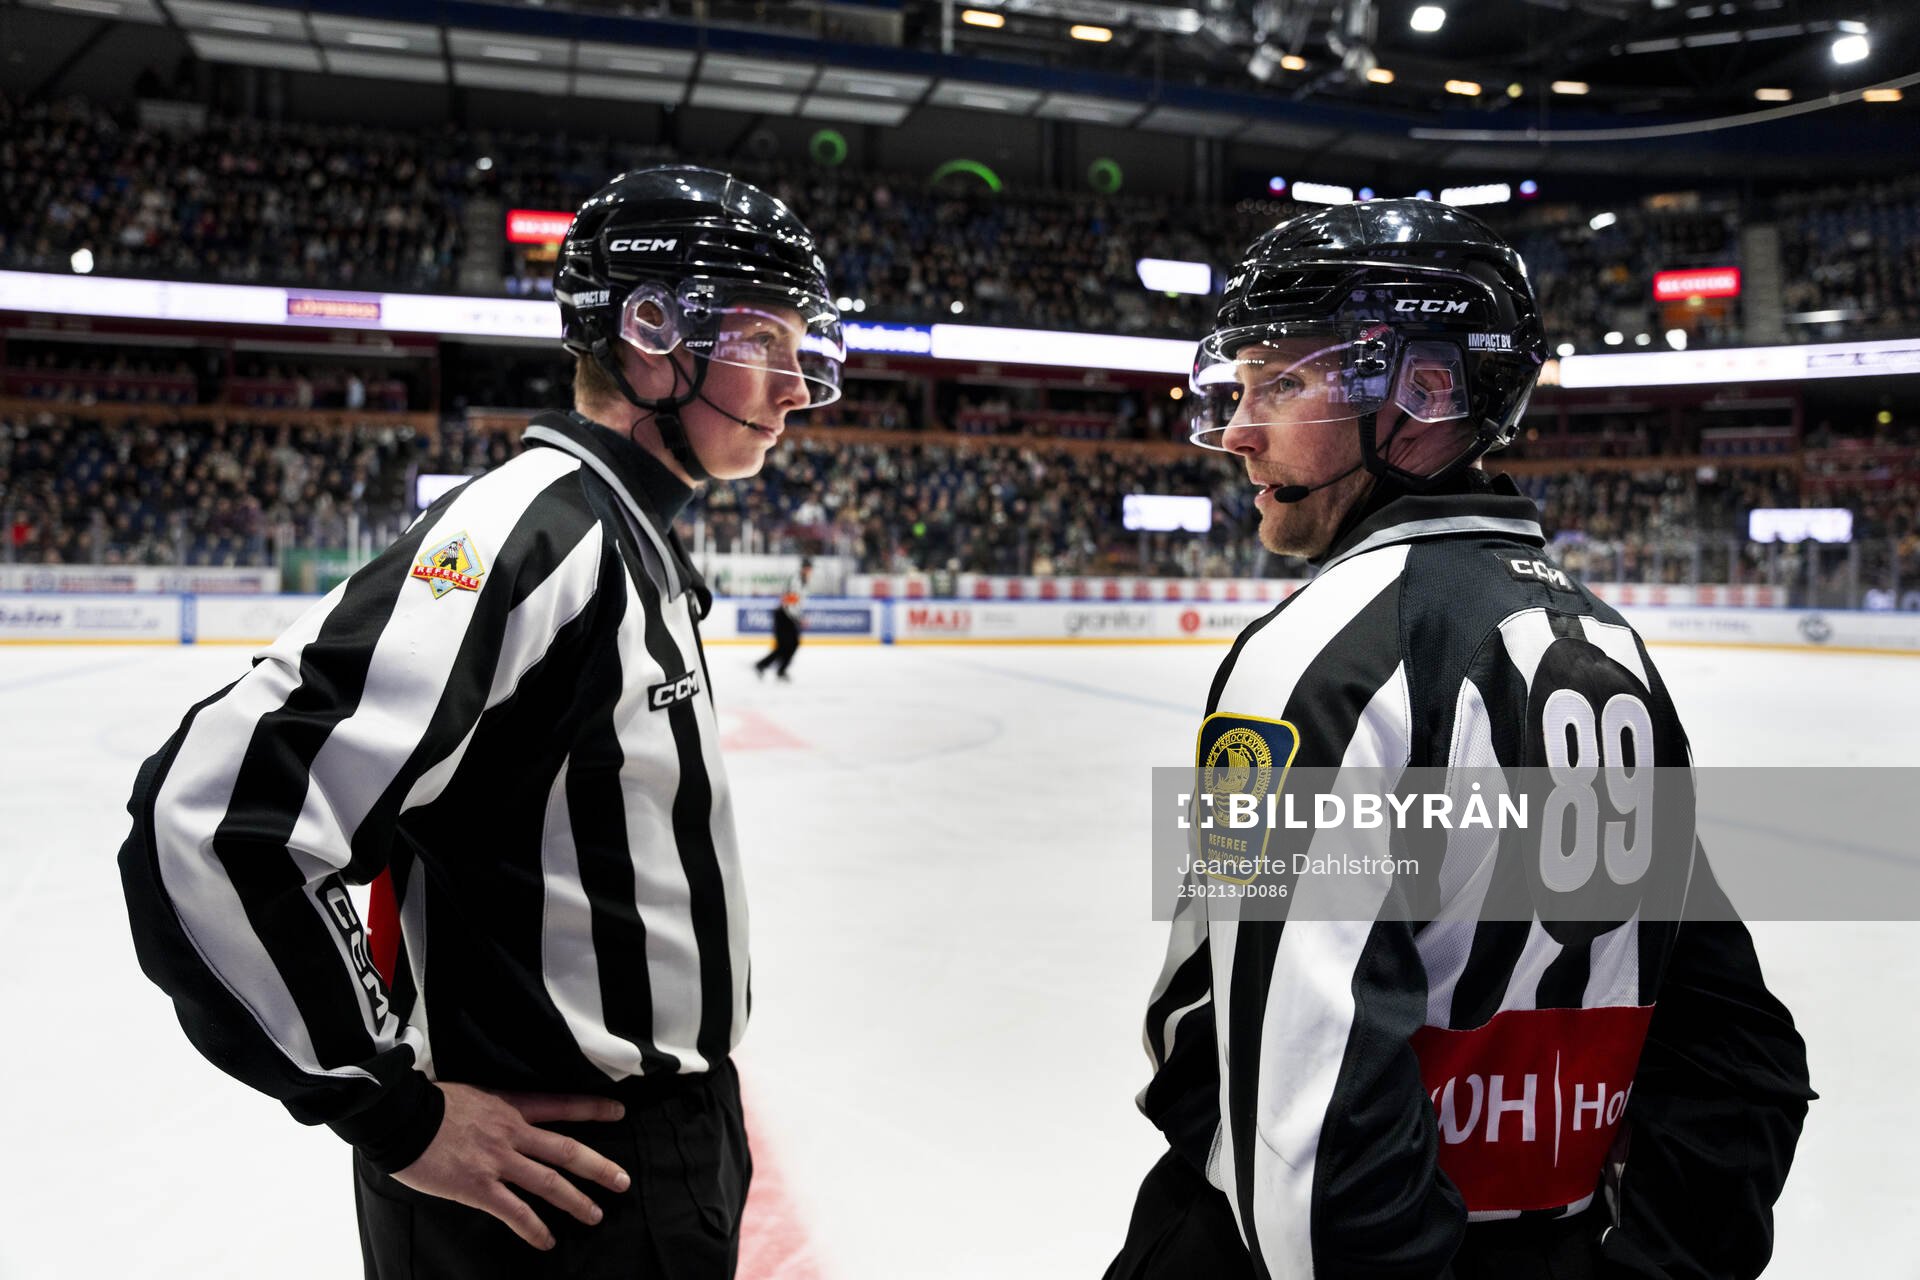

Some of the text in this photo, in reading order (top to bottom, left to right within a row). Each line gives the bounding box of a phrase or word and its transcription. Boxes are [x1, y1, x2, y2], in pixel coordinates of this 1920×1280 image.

[609, 239, 678, 252] CCM
[1394, 299, 1470, 314] CCM
[1468, 333, 1512, 349] IMPACT BY
[416, 566, 477, 587] REFEREE
[1510, 559, 1572, 591] CCM
[653, 674, 699, 706] CCM
[1539, 689, 1654, 893] 89
[1208, 833, 1248, 852] REFEREE
[326, 887, 389, 1020] CCM
